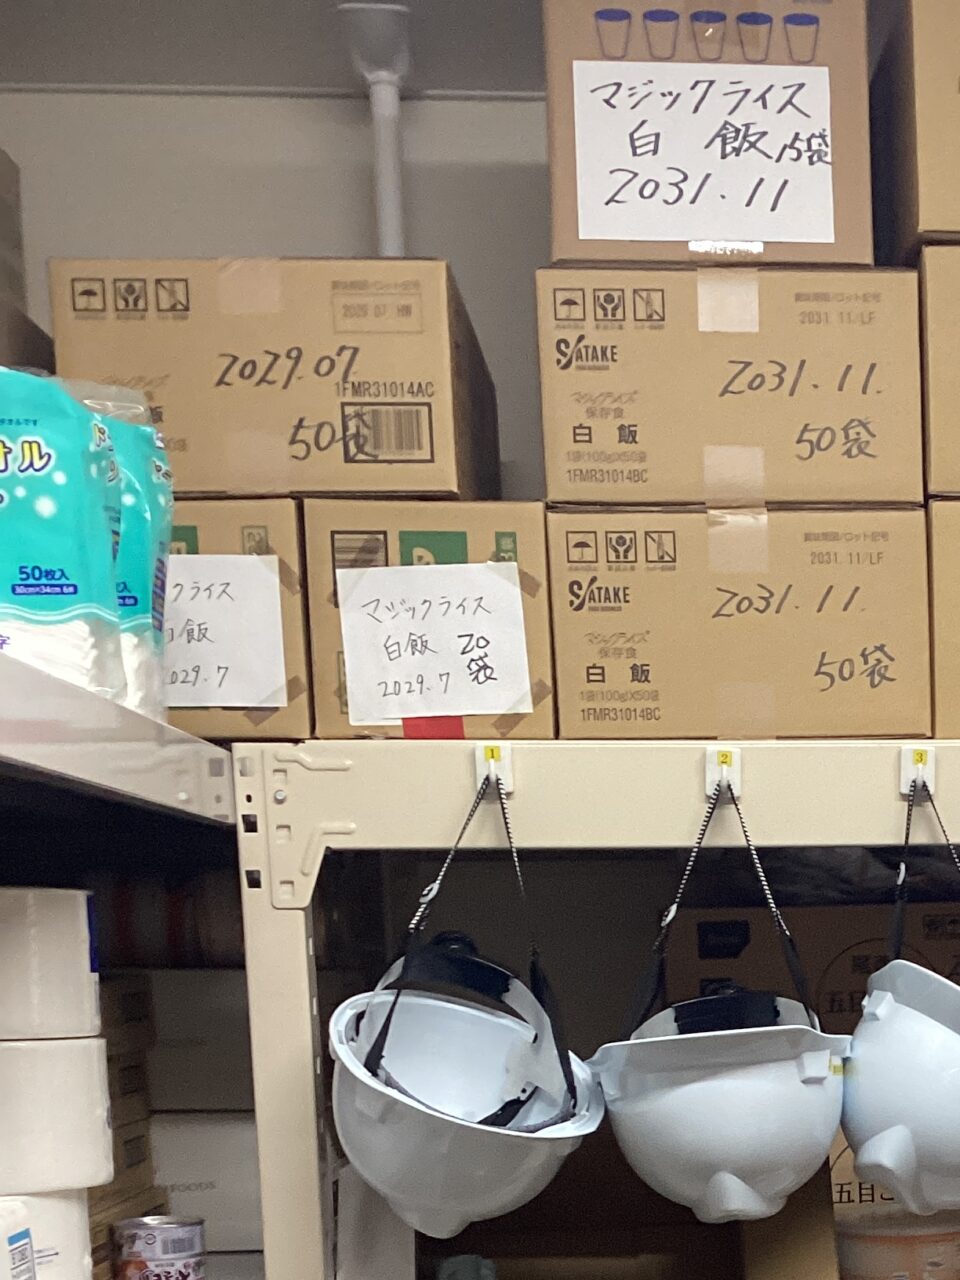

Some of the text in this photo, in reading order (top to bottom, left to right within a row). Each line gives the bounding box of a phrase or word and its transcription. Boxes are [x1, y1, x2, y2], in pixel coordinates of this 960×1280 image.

[590, 80, 811, 118] マジックライス
[628, 119, 661, 157] 白
[704, 119, 773, 160] 飯
[604, 166, 789, 212] 2031.11
[555, 333, 618, 371] SATAKE
[214, 345, 360, 391] 2029.07
[335, 381, 435, 398] 1FMR31014AC
[573, 423, 639, 444] 白 飯
[795, 417, 878, 460] 50袋
[566, 468, 649, 484] 1FMR31014BC
[18, 565, 70, 582] 50枚入
[568, 575, 631, 612] SATAKE
[361, 595, 492, 624] マジックライス
[383, 631, 438, 662] 白飯
[169, 665, 229, 689] 029.7
[586, 663, 651, 683] 白 飯
[813, 643, 896, 692] 50袋
[580, 707, 661, 722] 1FMR31014BC
